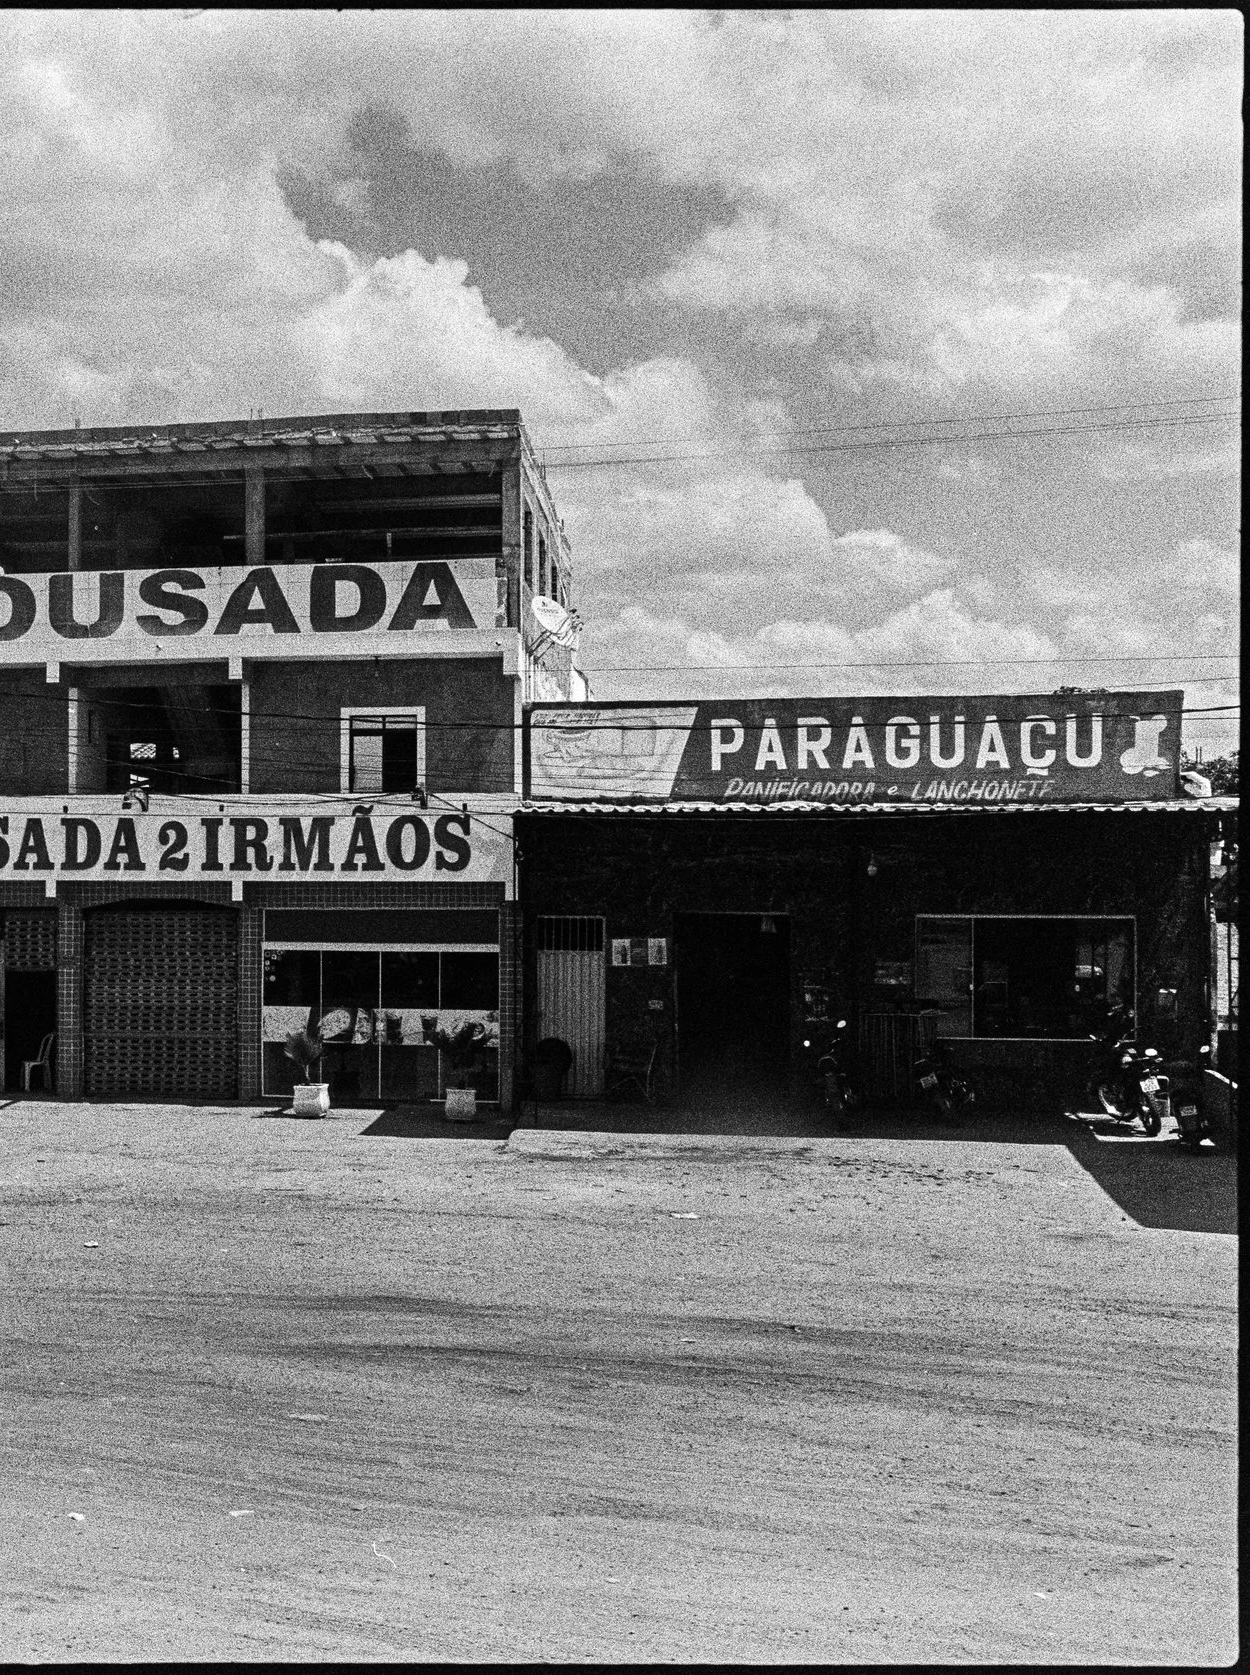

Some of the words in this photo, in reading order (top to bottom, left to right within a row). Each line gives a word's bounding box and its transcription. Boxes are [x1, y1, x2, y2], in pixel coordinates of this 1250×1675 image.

[710, 713, 1103, 776] PARAGUAÇU
[158, 820, 190, 871] 2
[200, 804, 472, 872] IRMÃOS
